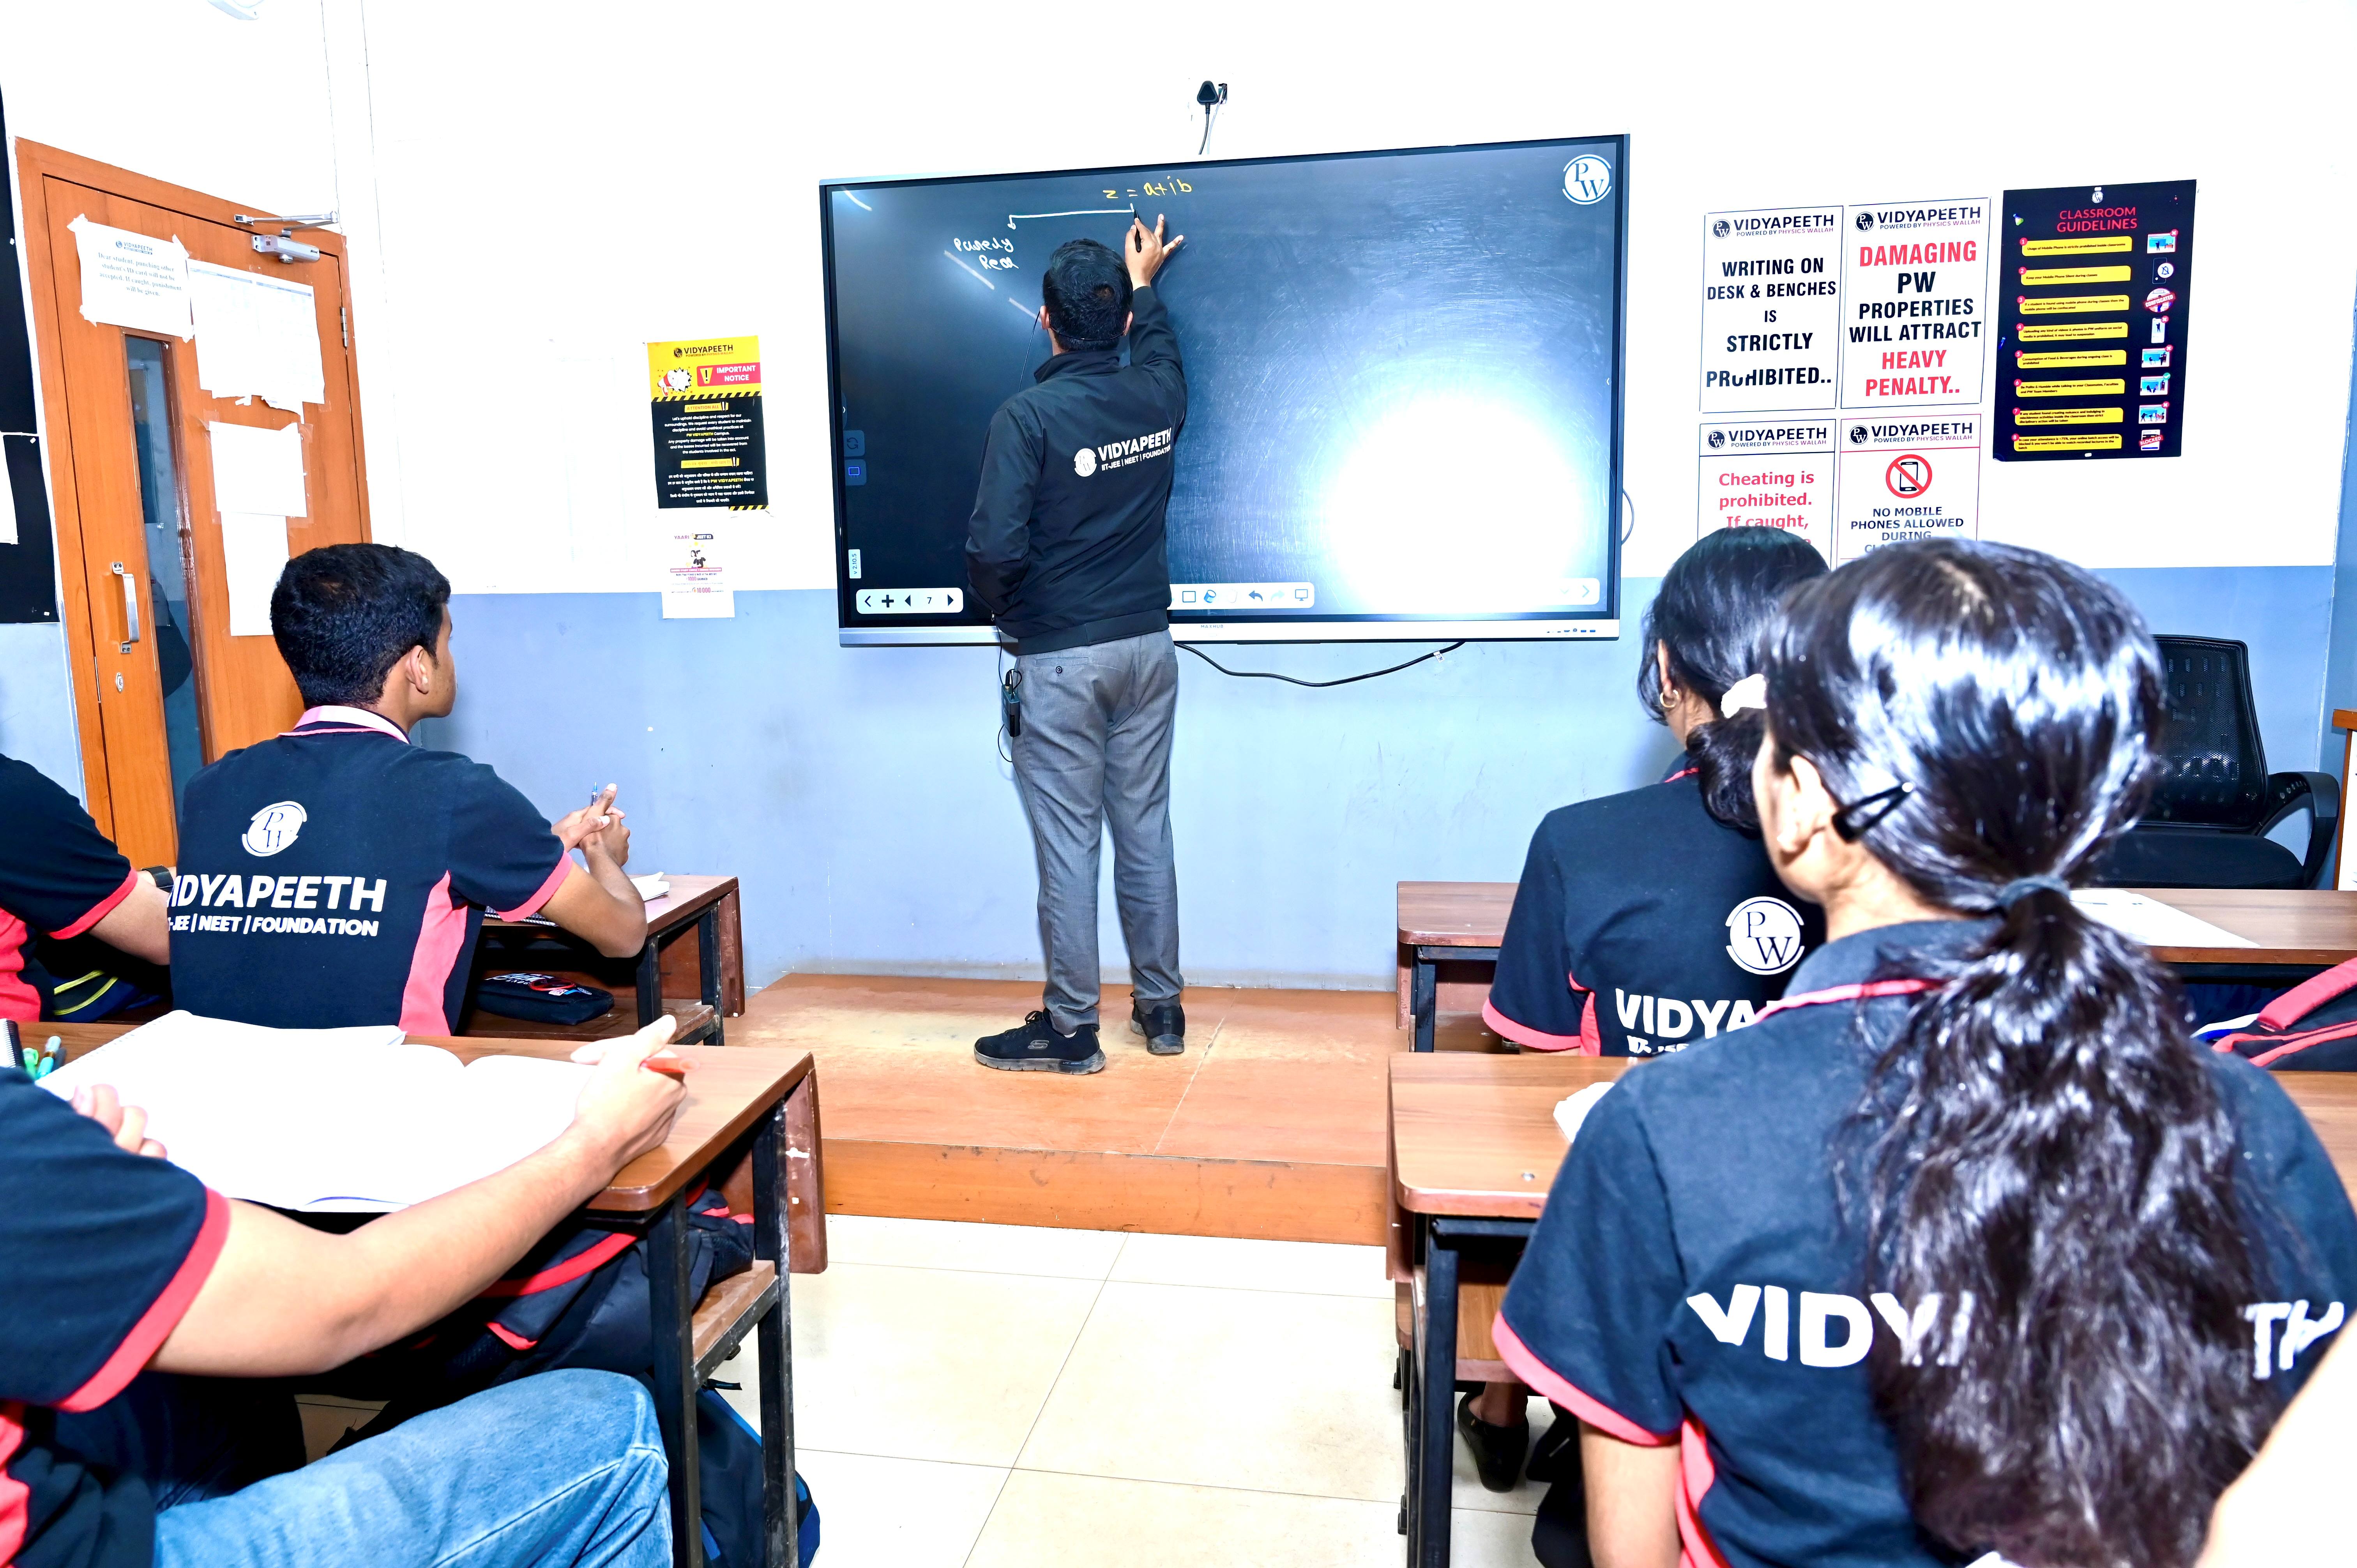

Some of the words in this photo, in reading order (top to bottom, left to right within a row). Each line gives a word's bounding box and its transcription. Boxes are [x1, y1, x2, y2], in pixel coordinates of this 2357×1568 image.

[1877, 207, 1981, 223] VIDYAPEETH
[2059, 207, 2136, 219] CLASSROOM
[1734, 215, 1834, 230] VIDYAPEETH
[2057, 218, 2138, 232] GUIDELINES
[124, 242, 152, 251] VIDYAPEETH
[1860, 241, 1977, 267] DAMAGING
[136, 261, 159, 270] punching
[1722, 258, 1794, 277] WRITING
[1801, 258, 1823, 274] ON
[152, 282, 182, 291] punishment
[1897, 271, 1936, 294] PW
[1707, 285, 1744, 300] DESK
[1750, 284, 1760, 298] &
[1767, 281, 1836, 297] BENCHES
[2145, 294, 2174, 308] CONFISCATED
[1764, 310, 1777, 323] IS
[1859, 298, 1974, 320] PROPERTIES
[1849, 326, 1892, 343] WILL
[1899, 321, 1982, 341] ATTRACT
[684, 344, 733, 354] VIDYAPEETH
[1727, 333, 1813, 352] STRICTLY
[1882, 350, 1947, 370] HEAVY
[717, 365, 756, 373] IMPORTANT
[1866, 376, 1960, 397] PENALTY..
[1728, 427, 1827, 441] VIDYAPEETH
[1871, 423, 1973, 437] VIDYAPEETH
[1097, 427, 1171, 461] VIDYAPEETH
[2140, 436, 2161, 445] BLOCKED
[1124, 455, 1139, 466] NEET
[1719, 471, 1795, 488] Cheating
[1801, 471, 1814, 484] is
[1719, 493, 1812, 510] prohibited.
[1873, 507, 1891, 517] NO
[1894, 507, 1942, 516] MOBILE
[1726, 516, 1741, 528] If
[1746, 514, 1809, 531] caught,
[1851, 520, 1901, 530] PHONES
[1904, 518, 1964, 528] ALLOWED
[1882, 531, 1932, 541] DURING
[167, 874, 387, 912] IDYAPEETH
[168, 915, 191, 931] -JEE
[198, 915, 242, 932] NEET
[252, 916, 379, 937] FOUNDATION
[1615, 988, 1781, 1039] VIDYA
